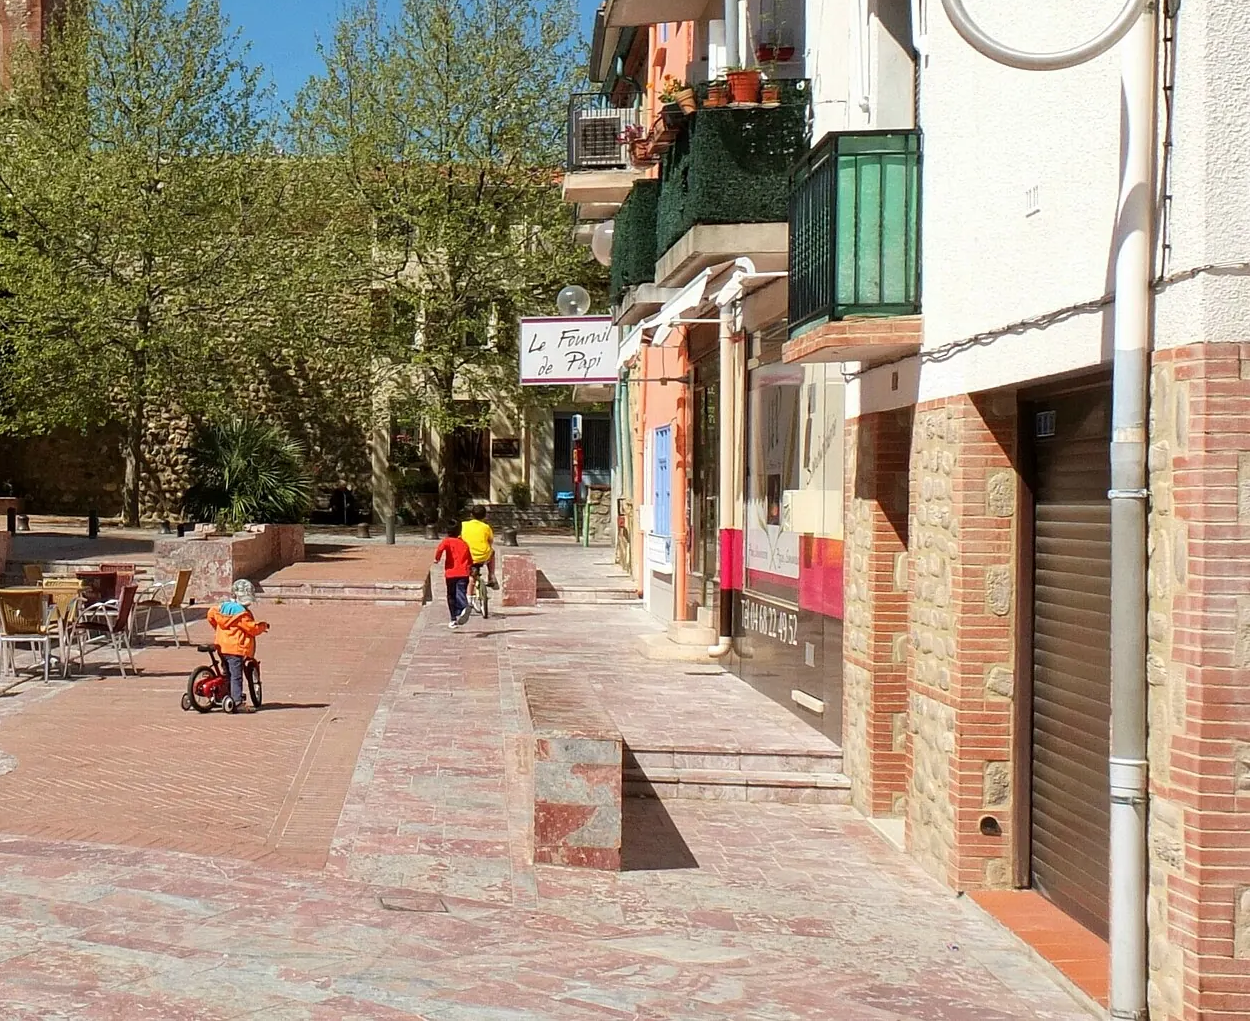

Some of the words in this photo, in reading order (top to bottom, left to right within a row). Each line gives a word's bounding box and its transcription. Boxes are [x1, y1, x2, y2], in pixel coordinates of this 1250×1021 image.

[528, 333, 546, 354] Le
[557, 323, 612, 349] Fournil
[538, 355, 553, 376] de
[564, 351, 603, 379] Papi
[750, 602, 758, 631] 04
[759, 604, 768, 635] 68
[768, 607, 777, 638] 22
[778, 611, 787, 643] 49
[788, 614, 798, 646] 52
